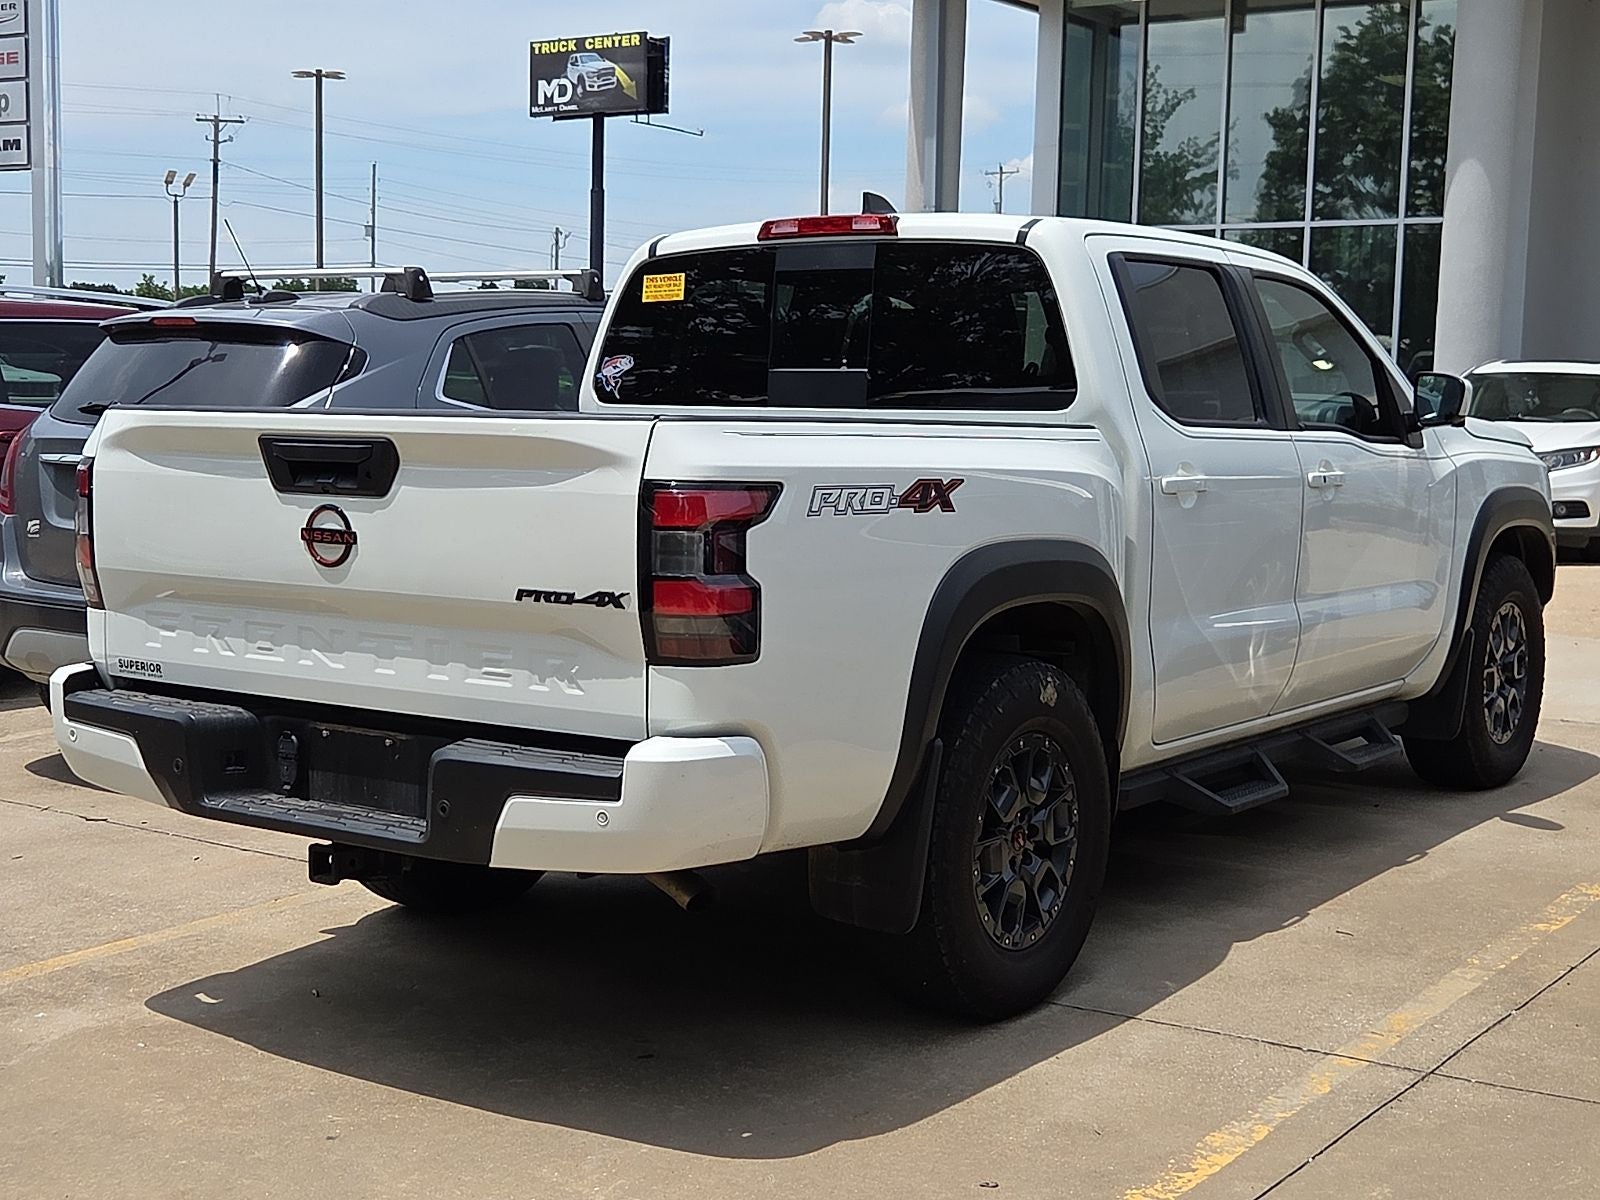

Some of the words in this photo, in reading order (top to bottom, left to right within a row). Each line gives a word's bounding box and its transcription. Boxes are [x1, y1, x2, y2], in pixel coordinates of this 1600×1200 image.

[532, 40, 577, 55] TRUCK
[585, 33, 641, 50] CENTER
[537, 78, 573, 105] MD
[302, 530, 355, 543] NISSAN
[144, 609, 585, 696] FRONTIER
[118, 658, 163, 674] SUPERIOR
